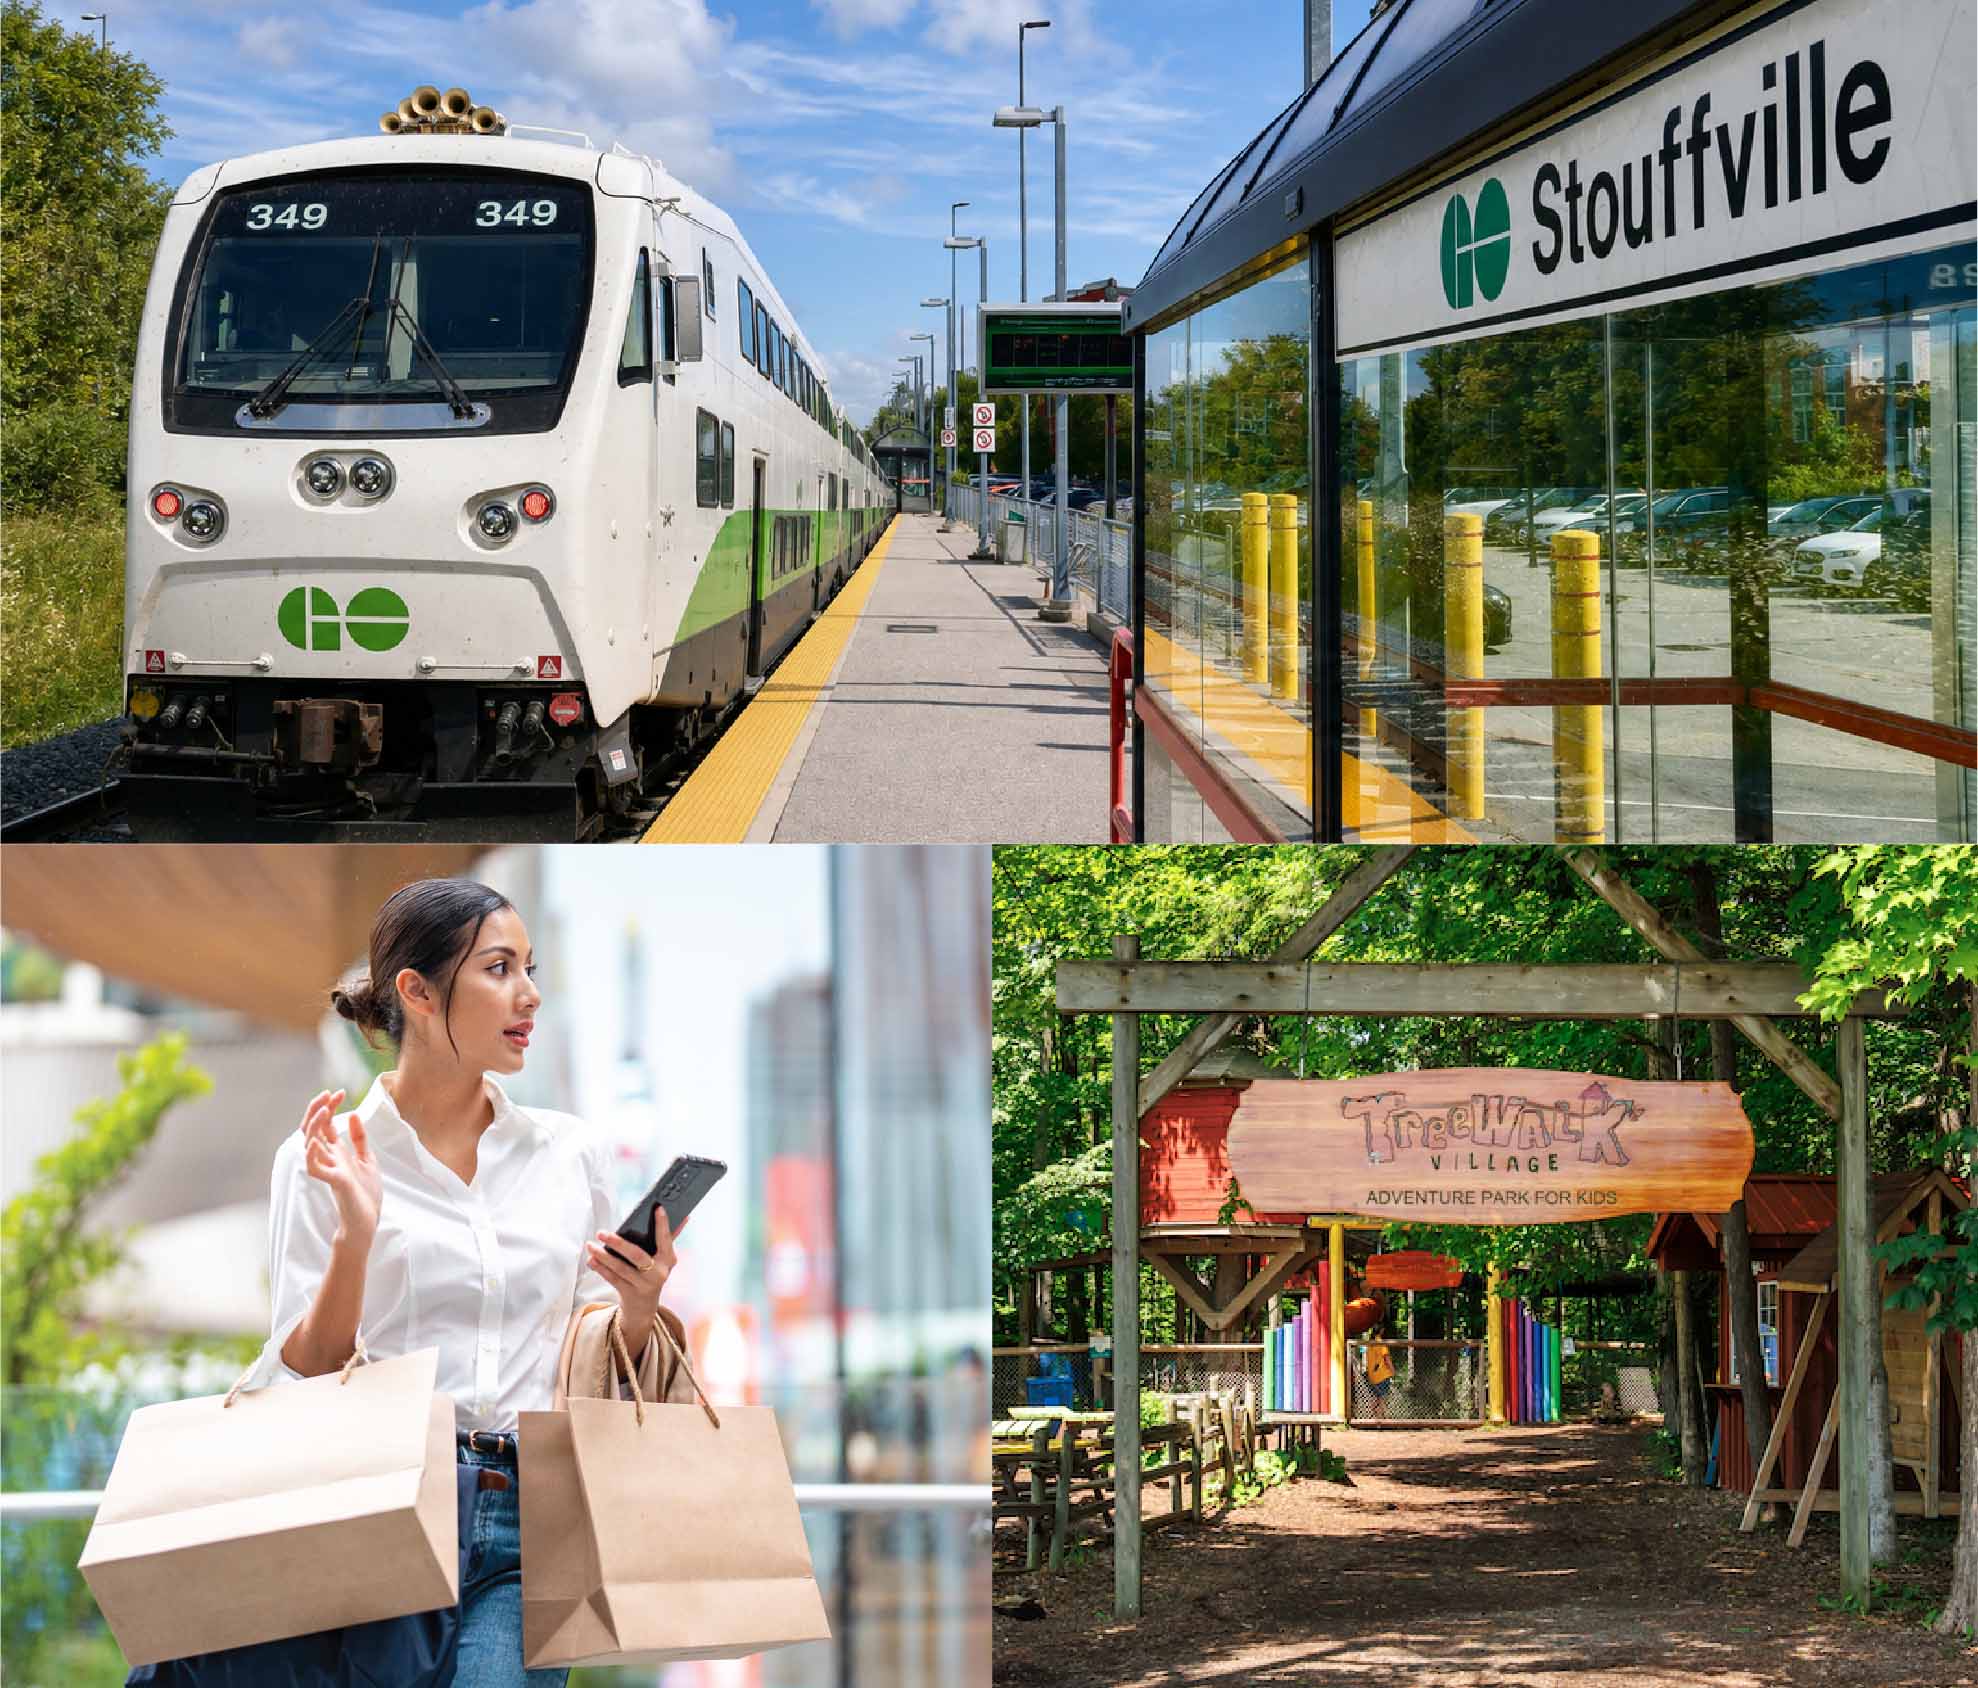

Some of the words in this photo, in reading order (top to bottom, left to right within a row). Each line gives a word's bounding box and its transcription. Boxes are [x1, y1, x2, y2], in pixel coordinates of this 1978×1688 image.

[1532, 40, 1892, 276] Stouffville
[246, 203, 328, 230] 349
[475, 200, 558, 227] 349
[1430, 1152, 1560, 1172] VILLAGE
[1366, 1190, 1477, 1206] ADVENTURE
[1481, 1190, 1529, 1206] PARK
[1535, 1190, 1572, 1206] FOR
[1576, 1190, 1618, 1206] KIDS
